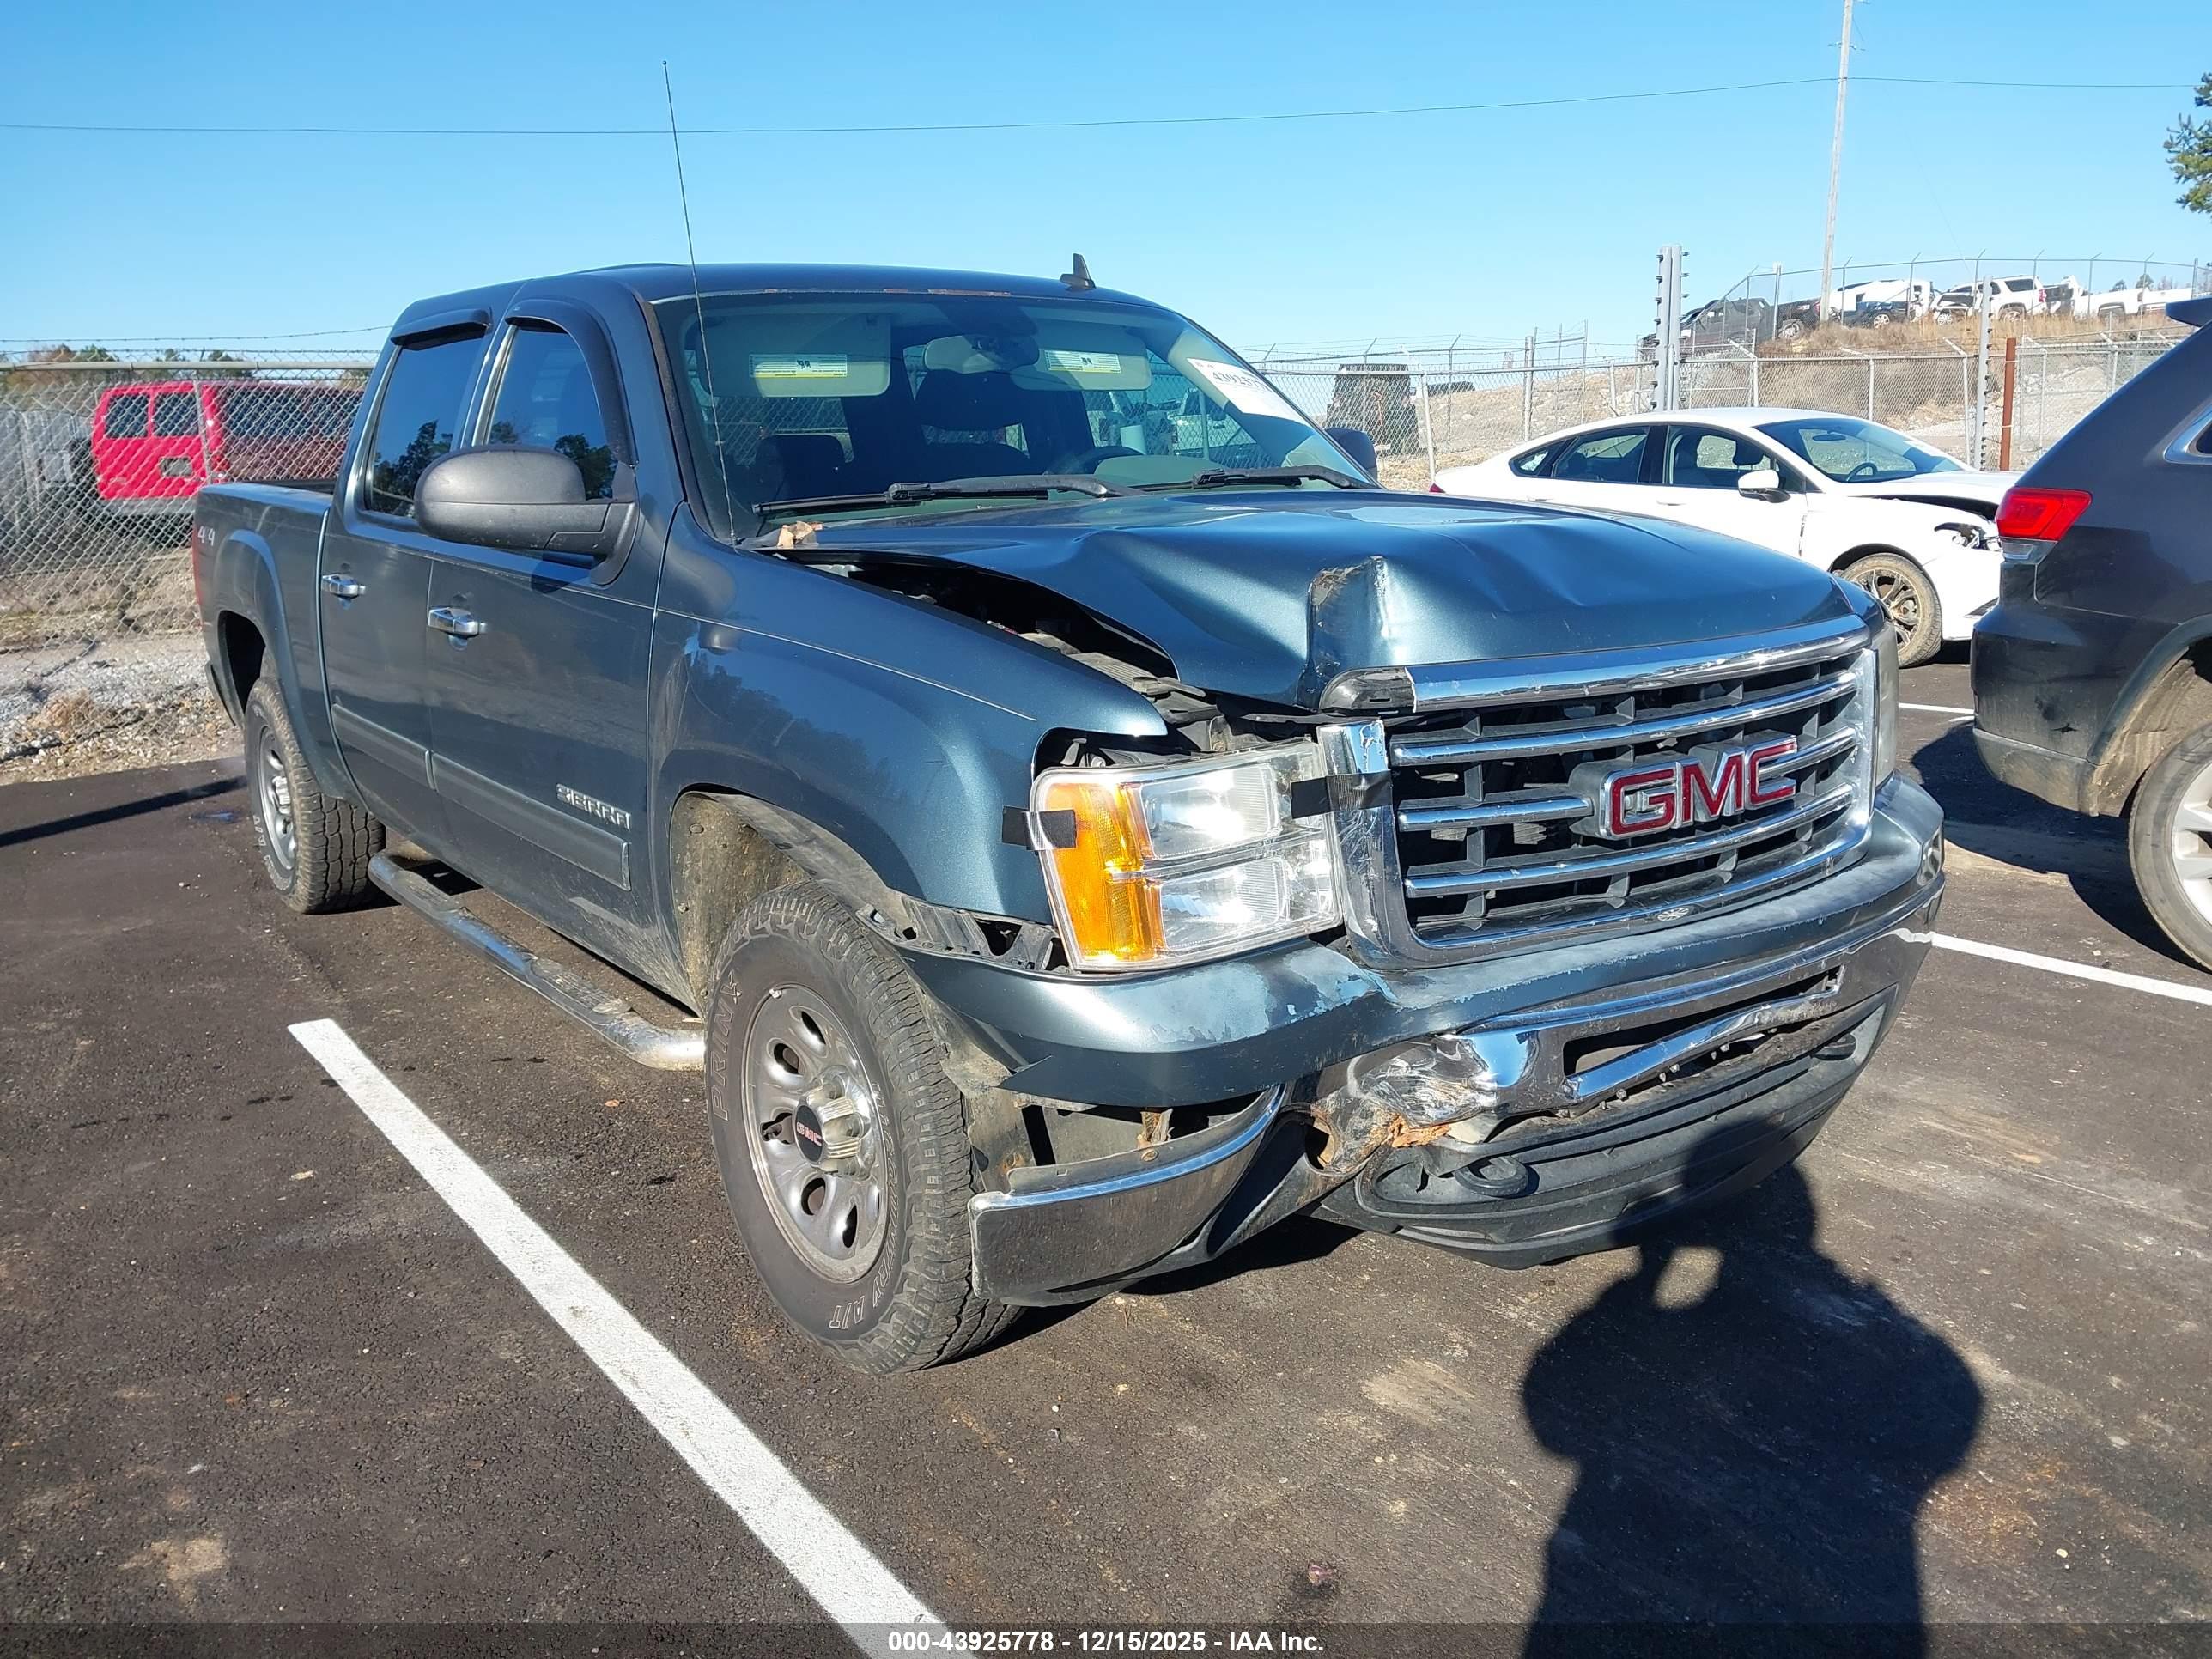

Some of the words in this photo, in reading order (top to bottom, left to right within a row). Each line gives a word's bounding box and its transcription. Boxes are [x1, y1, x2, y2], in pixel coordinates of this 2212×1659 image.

[556, 782, 632, 831] SIERRA
[1605, 734, 1797, 840] GMC
[710, 967, 742, 1121] PRINX
[796, 1121, 823, 1147] GMC
[828, 1295, 865, 1329] A/T
